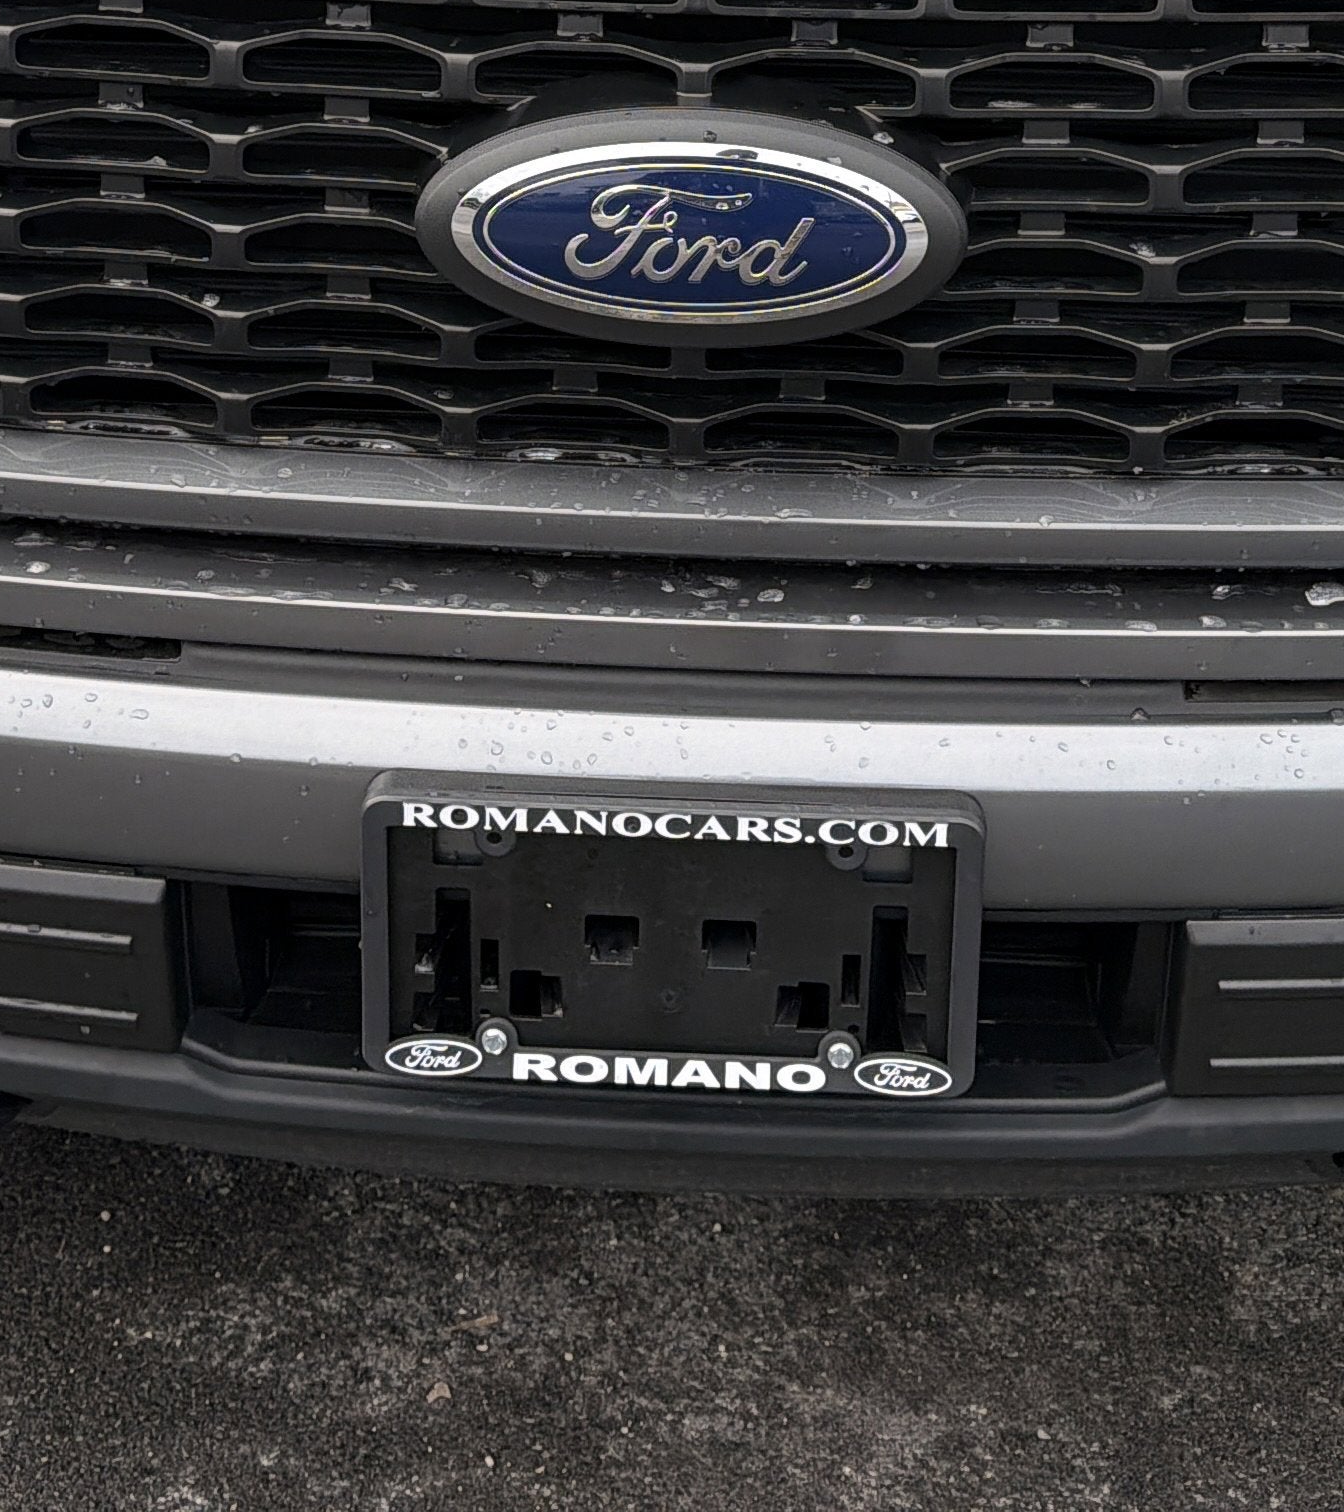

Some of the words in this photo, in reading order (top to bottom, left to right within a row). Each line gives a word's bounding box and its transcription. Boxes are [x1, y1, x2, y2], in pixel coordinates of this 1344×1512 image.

[563, 183, 816, 287] Ford
[400, 800, 951, 849] ROMANOCARS.COM
[404, 1044, 463, 1069] Ford
[511, 1051, 828, 1093] ROMANO
[873, 1062, 932, 1089] Ford
